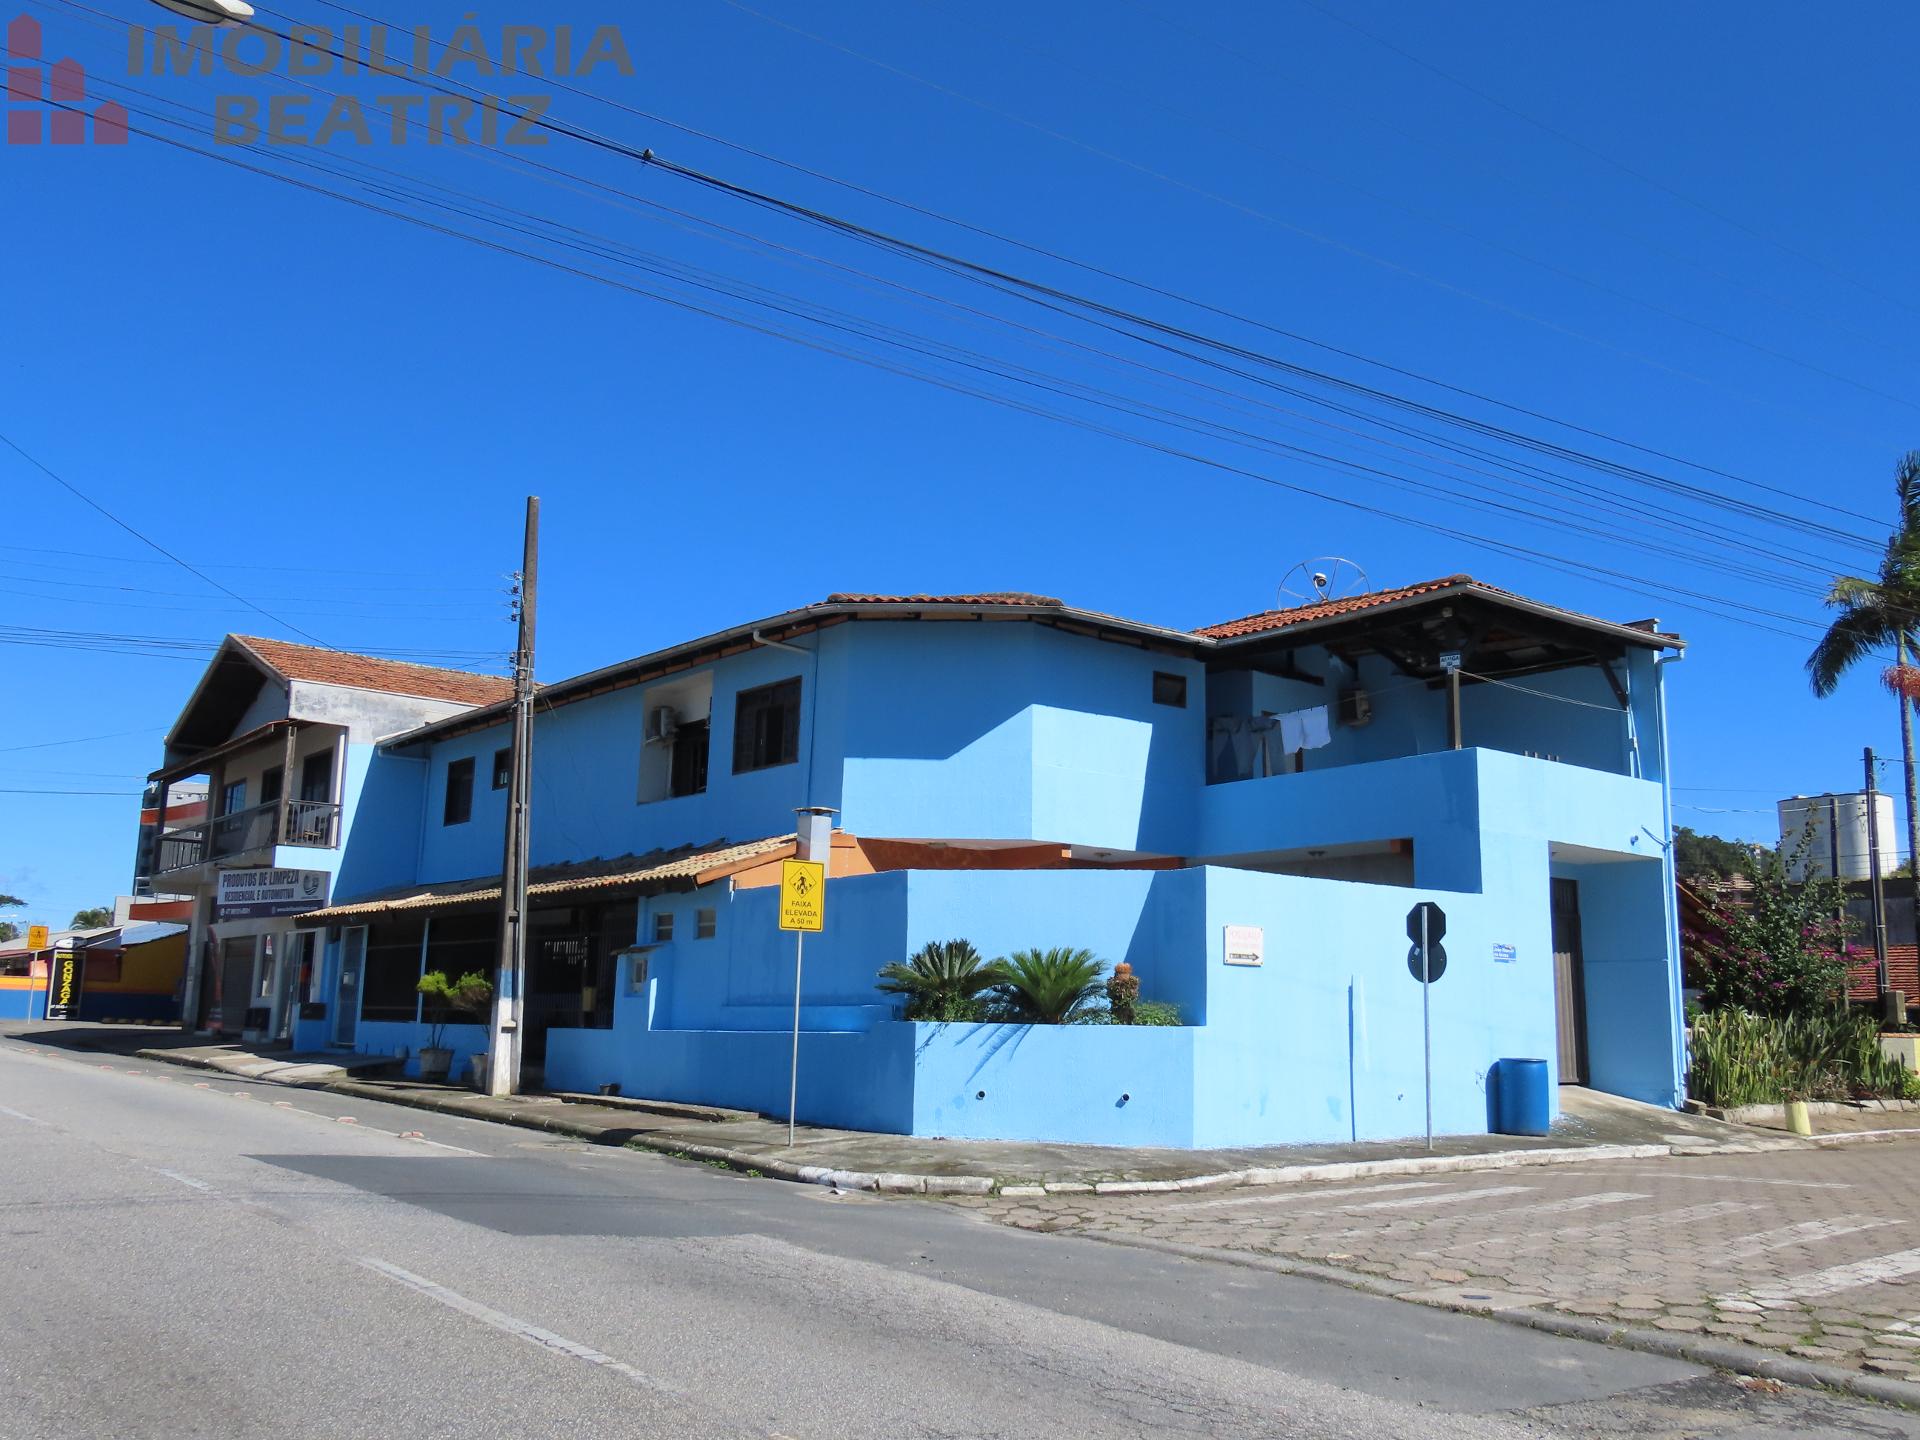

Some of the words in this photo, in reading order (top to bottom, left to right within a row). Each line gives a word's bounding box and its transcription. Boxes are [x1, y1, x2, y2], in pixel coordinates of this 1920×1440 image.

[223, 873, 257, 888] PRODUTOS
[259, 871, 268, 886] DE
[269, 870, 299, 885] LIMPEZA
[785, 909, 817, 917] ELEVADA
[60, 961, 73, 1004] GONZAGA
